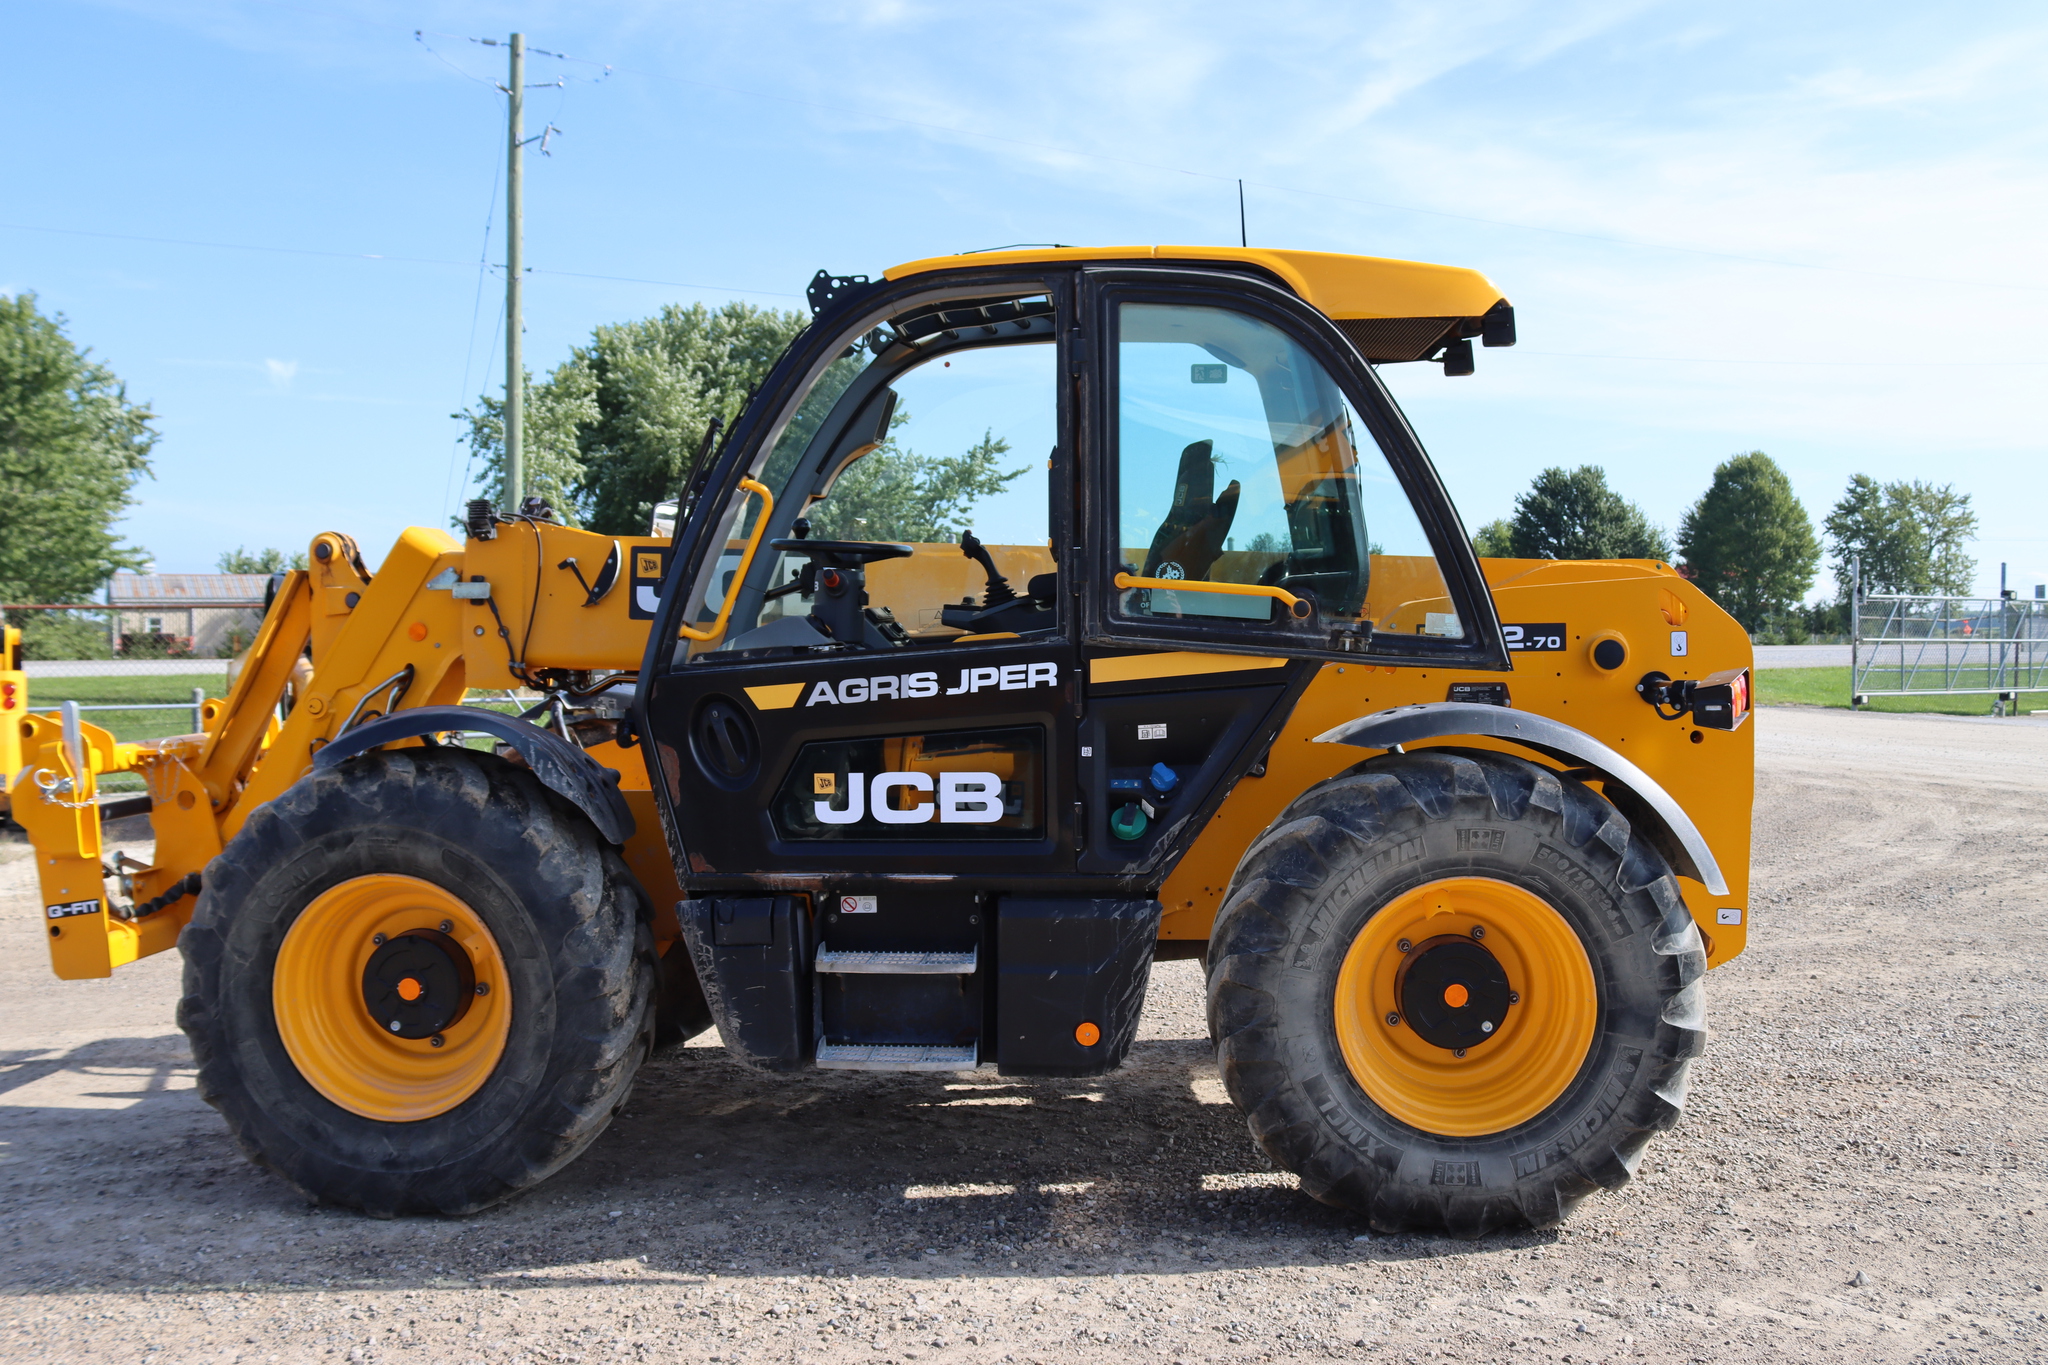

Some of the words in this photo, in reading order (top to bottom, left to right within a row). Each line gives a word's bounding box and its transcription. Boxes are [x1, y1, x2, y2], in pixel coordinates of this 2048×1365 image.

[643, 559, 658, 572] JCB
[814, 771, 1004, 824] JCB
[819, 776, 832, 789] JCB
[1309, 836, 1423, 939] MICHELIN
[1537, 847, 1596, 890] 500/70
[1318, 1093, 1386, 1159] XMCL
